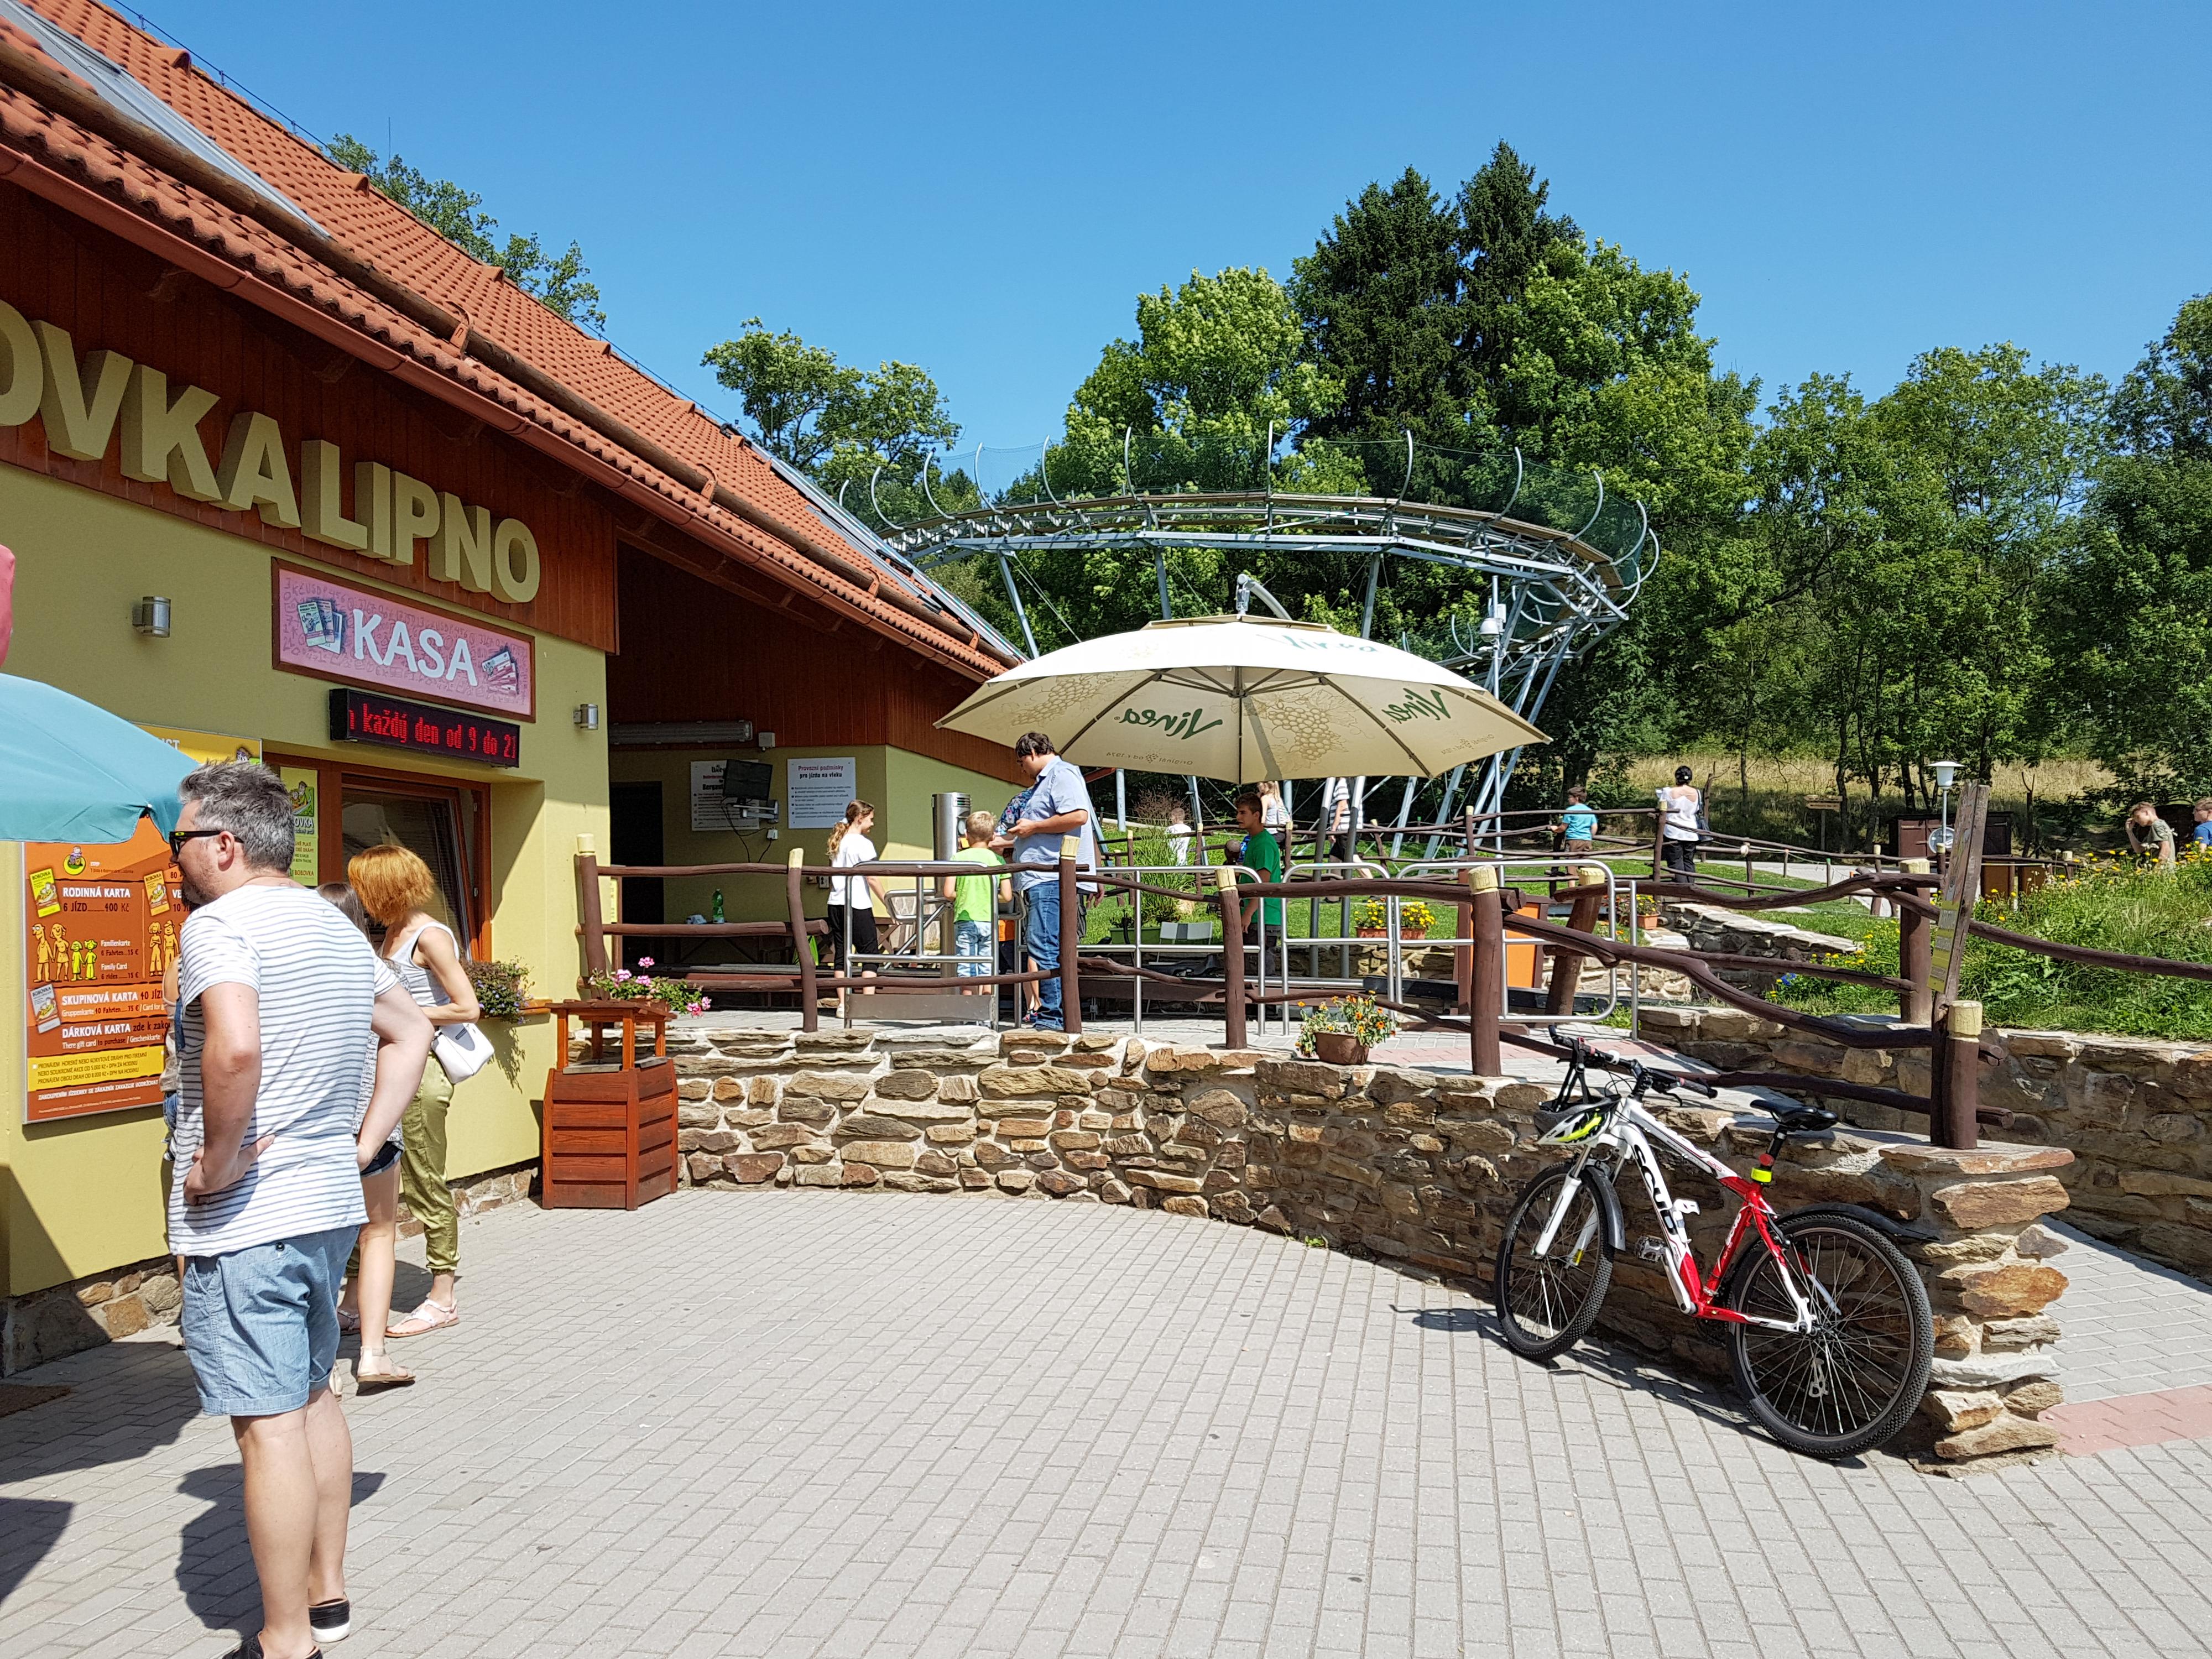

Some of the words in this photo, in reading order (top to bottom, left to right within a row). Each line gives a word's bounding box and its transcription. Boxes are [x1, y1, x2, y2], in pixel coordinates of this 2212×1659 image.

[301, 440, 540, 604] LIPNO
[353, 609, 478, 687] KASA
[363, 703, 408, 743] každý
[415, 717, 439, 744] den
[446, 724, 462, 749] od
[468, 727, 477, 751] 9
[483, 731, 498, 755] do
[294, 817, 314, 827] OVKA
[62, 886, 101, 898] RODINNÁ
[105, 888, 131, 898] KARTA
[121, 902, 129, 912] Kč
[62, 992, 109, 1005] SKUPINOVÁ
[112, 992, 138, 1001] KARTA
[62, 1024, 102, 1039] DÁRKOVÁ
[105, 1024, 131, 1035] KARTA
